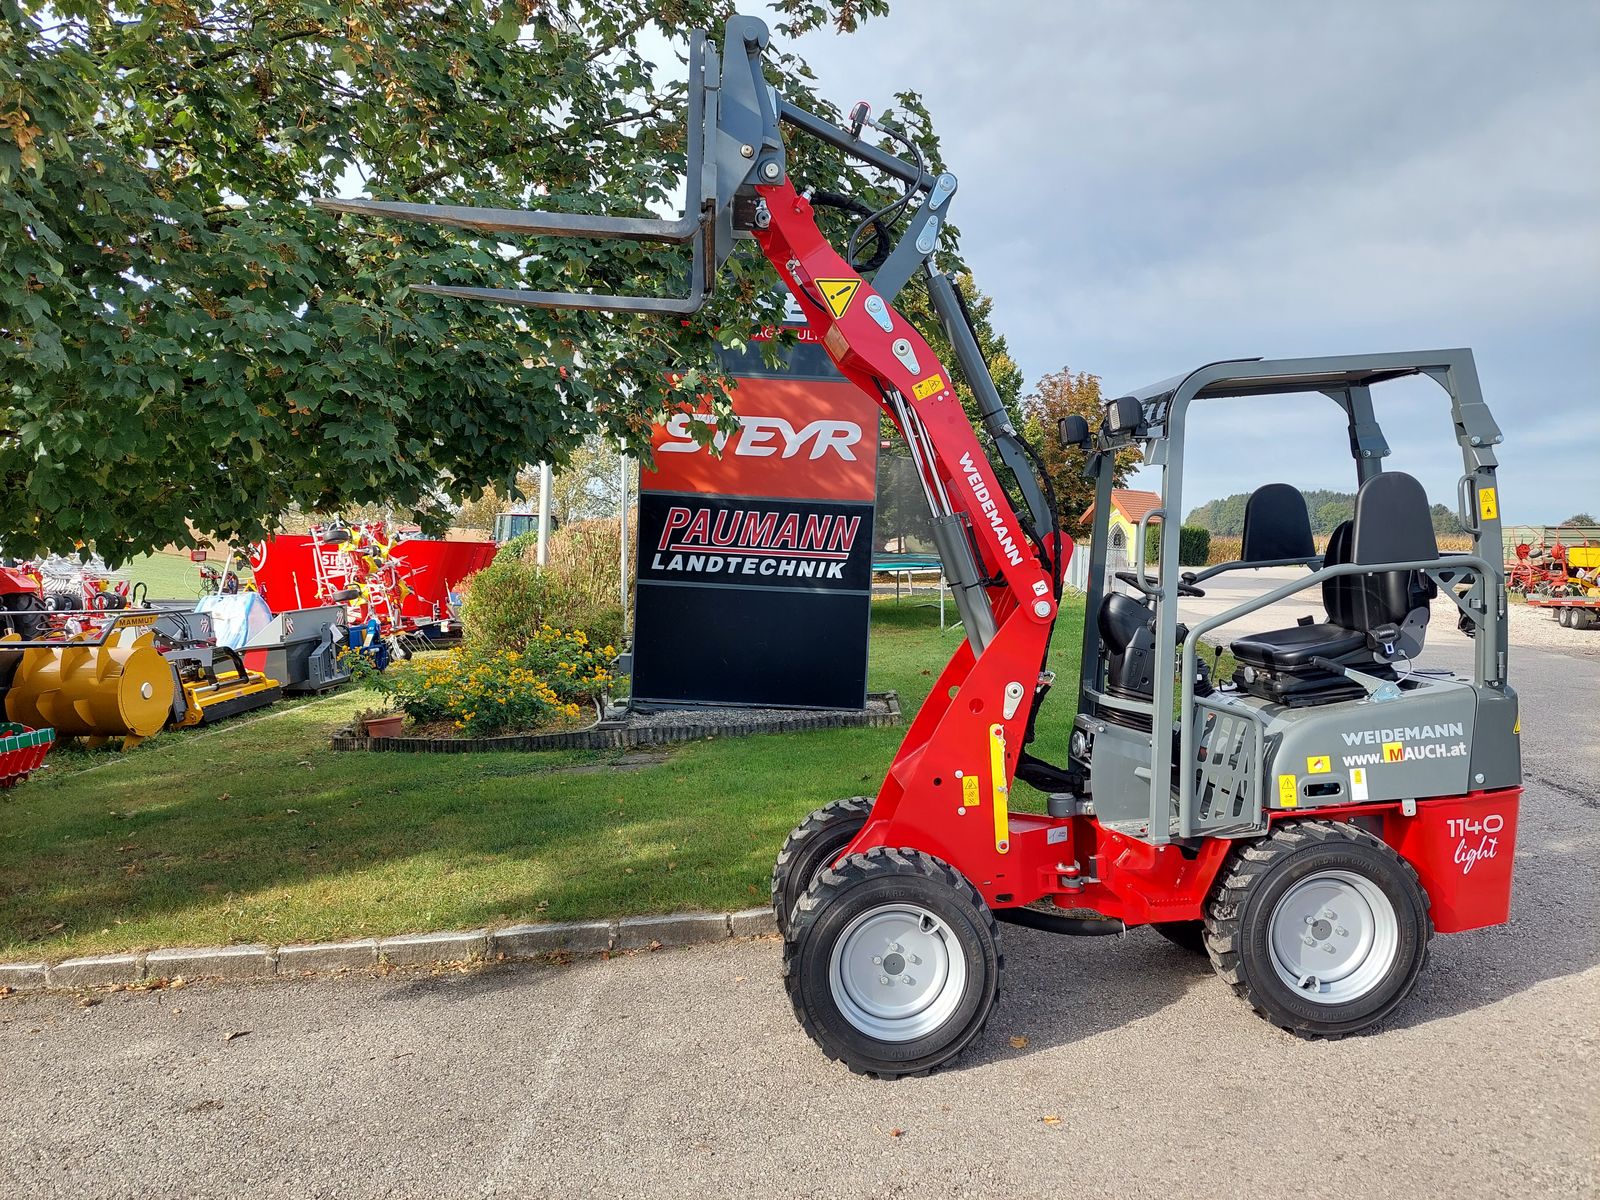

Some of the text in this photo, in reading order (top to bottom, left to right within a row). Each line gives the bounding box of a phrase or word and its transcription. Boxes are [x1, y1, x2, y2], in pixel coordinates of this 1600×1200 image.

[658, 413, 863, 461] STEYR
[959, 451, 1024, 567] WEIDEMANN
[658, 507, 861, 551] PAUMANN
[651, 553, 847, 579] LANDTECHNIK
[119, 616, 154, 627] MAMMUT
[1341, 722, 1464, 746] WEIDEMANN
[1342, 741, 1467, 767] www.MAUCH.at
[1446, 814, 1504, 838] 1140
[1454, 834, 1498, 875] light
